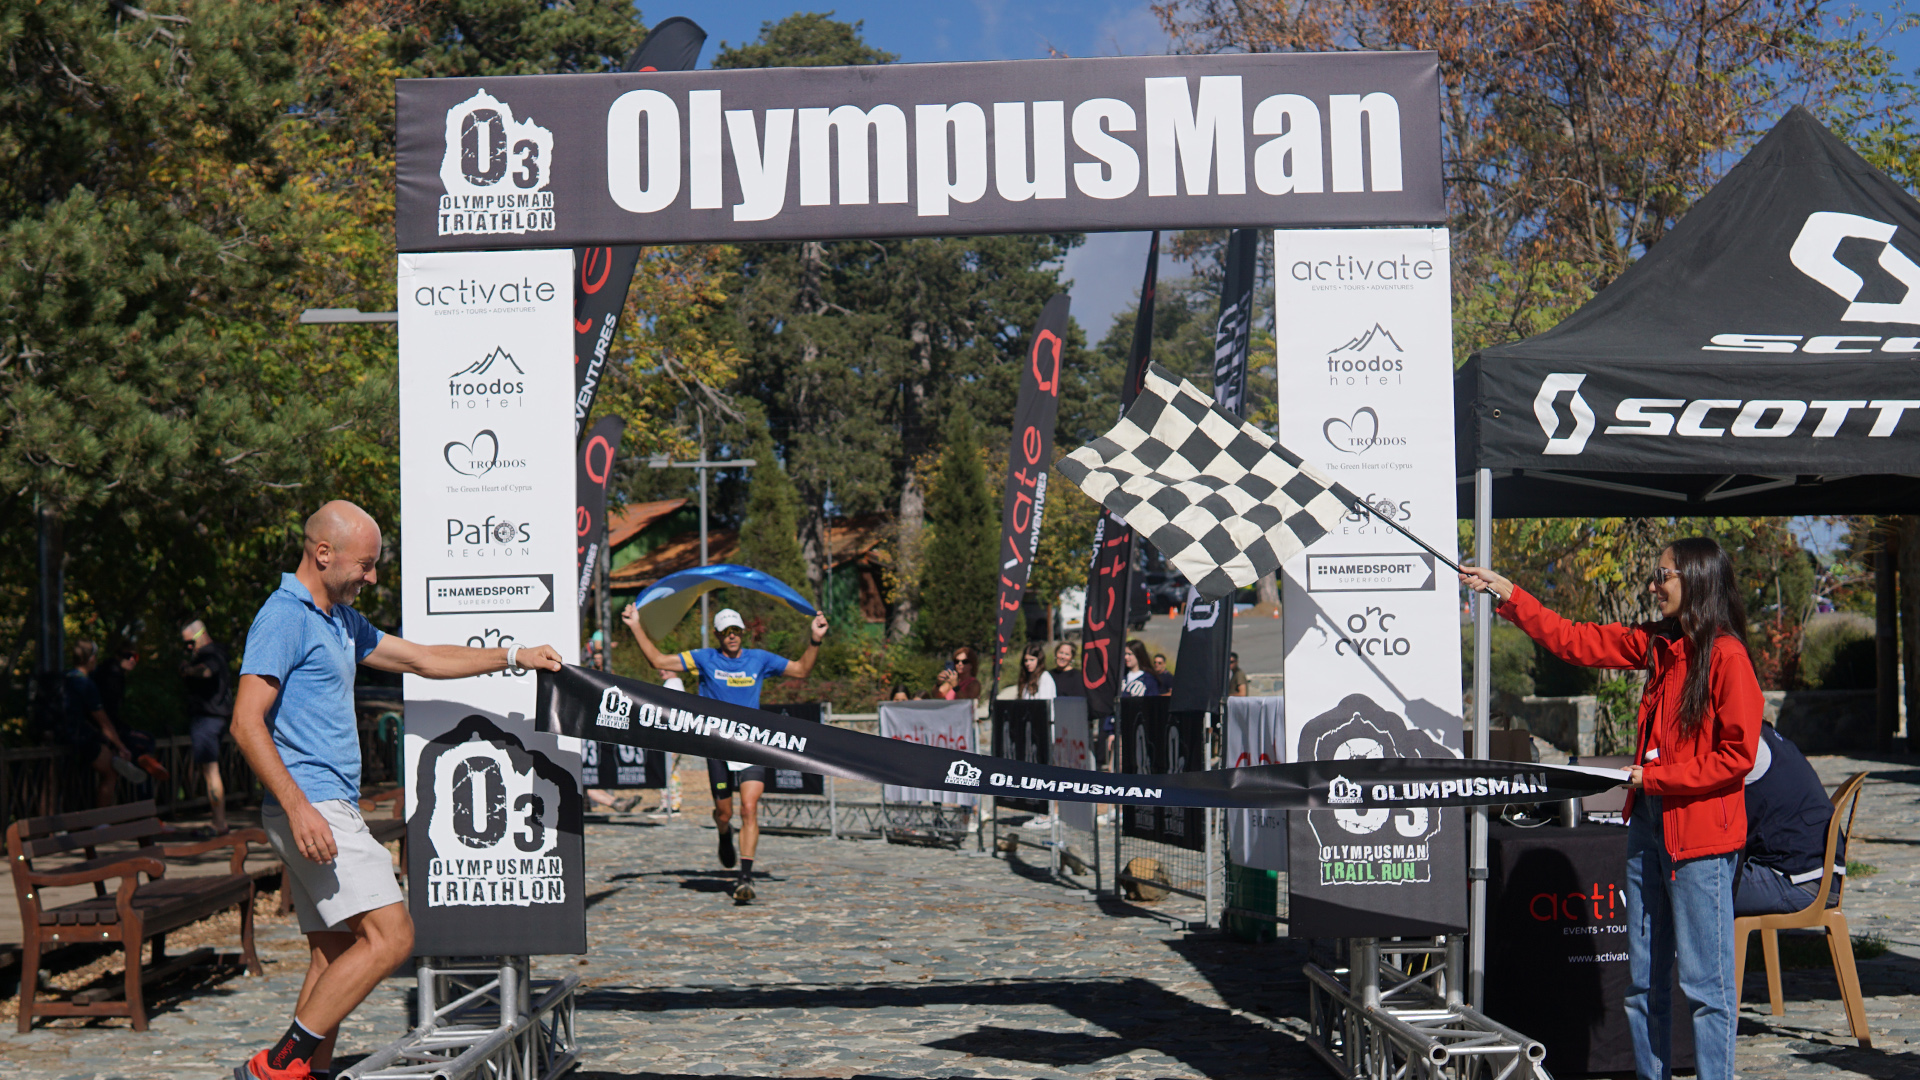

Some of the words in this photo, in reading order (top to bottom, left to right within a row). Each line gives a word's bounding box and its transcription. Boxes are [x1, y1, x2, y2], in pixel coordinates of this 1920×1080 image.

[607, 75, 1403, 222] OlympusMan
[443, 193, 551, 209] OLYMPUSMAN
[441, 212, 552, 232] TRIATHLON
[1291, 254, 1433, 281] activate
[415, 277, 555, 306] activate
[1327, 356, 1403, 372] troodos
[576, 312, 617, 436] VENTURES
[1330, 374, 1402, 386] hotel
[449, 379, 524, 396] troodos
[451, 396, 523, 409] hotel
[1604, 398, 1920, 438] SCOTT
[1348, 437, 1407, 446] TROODOS
[469, 459, 526, 469] TROODOS
[1390, 462, 1413, 471] Cyprus
[509, 484, 533, 493] Cyprus
[1346, 493, 1411, 522] afos
[447, 515, 530, 546] Pafos
[448, 547, 530, 558] REGION
[1329, 564, 1412, 575] NAMEDSPORT
[449, 586, 531, 597] NAMEDSPORT
[458, 598, 511, 607] SUPERFOOD
[1335, 637, 1411, 656] CYCLO
[639, 703, 807, 752] OLUMPUSMAN
[989, 772, 1162, 799] OLUMPUSMAN
[1372, 773, 1548, 800] OLUMPUSMAN
[1322, 844, 1426, 861] OLYMPUSMAN
[432, 858, 560, 877] OLYMPUSMAN
[1323, 862, 1375, 881] TRAIL
[1381, 862, 1415, 881] RUN
[430, 880, 561, 902] TRIATHLON
[1529, 882, 1627, 921] acti
[1563, 926, 1598, 935] EVENTS
[1606, 925, 1627, 934] TOU
[1568, 952, 1629, 963] www.activat
